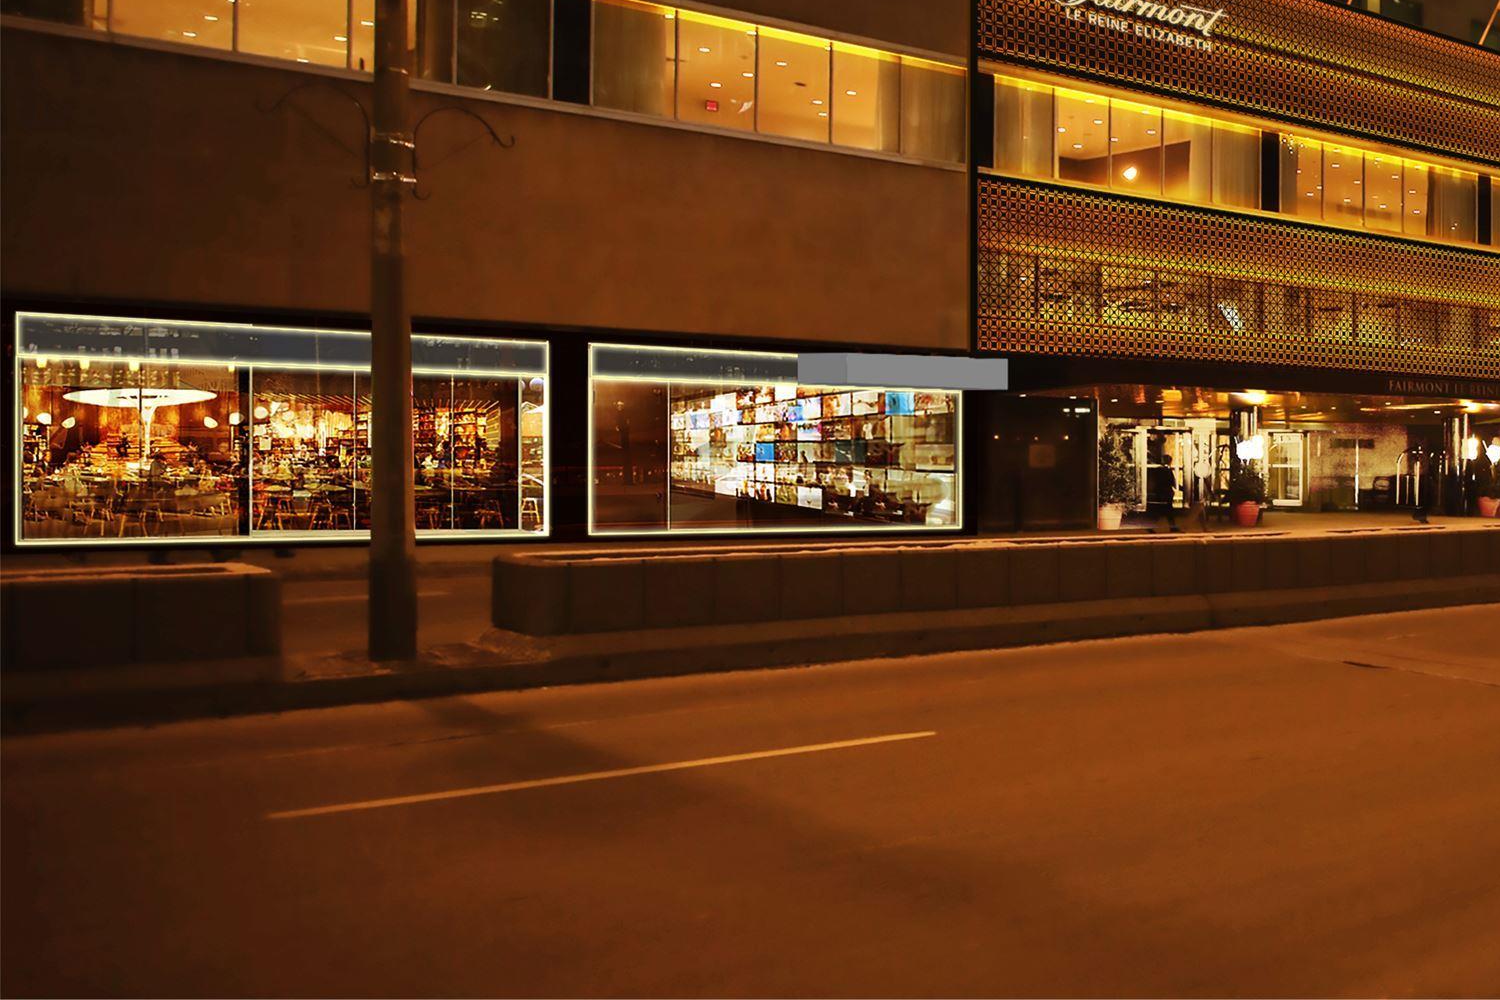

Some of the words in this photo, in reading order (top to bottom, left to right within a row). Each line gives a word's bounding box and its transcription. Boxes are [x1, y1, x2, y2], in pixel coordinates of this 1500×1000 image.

[1065, 7, 1082, 22] LE
[1088, 10, 1130, 33] REINE
[1135, 25, 1214, 51] ELIZABETH
[1388, 380, 1449, 394] FAIRMONT
